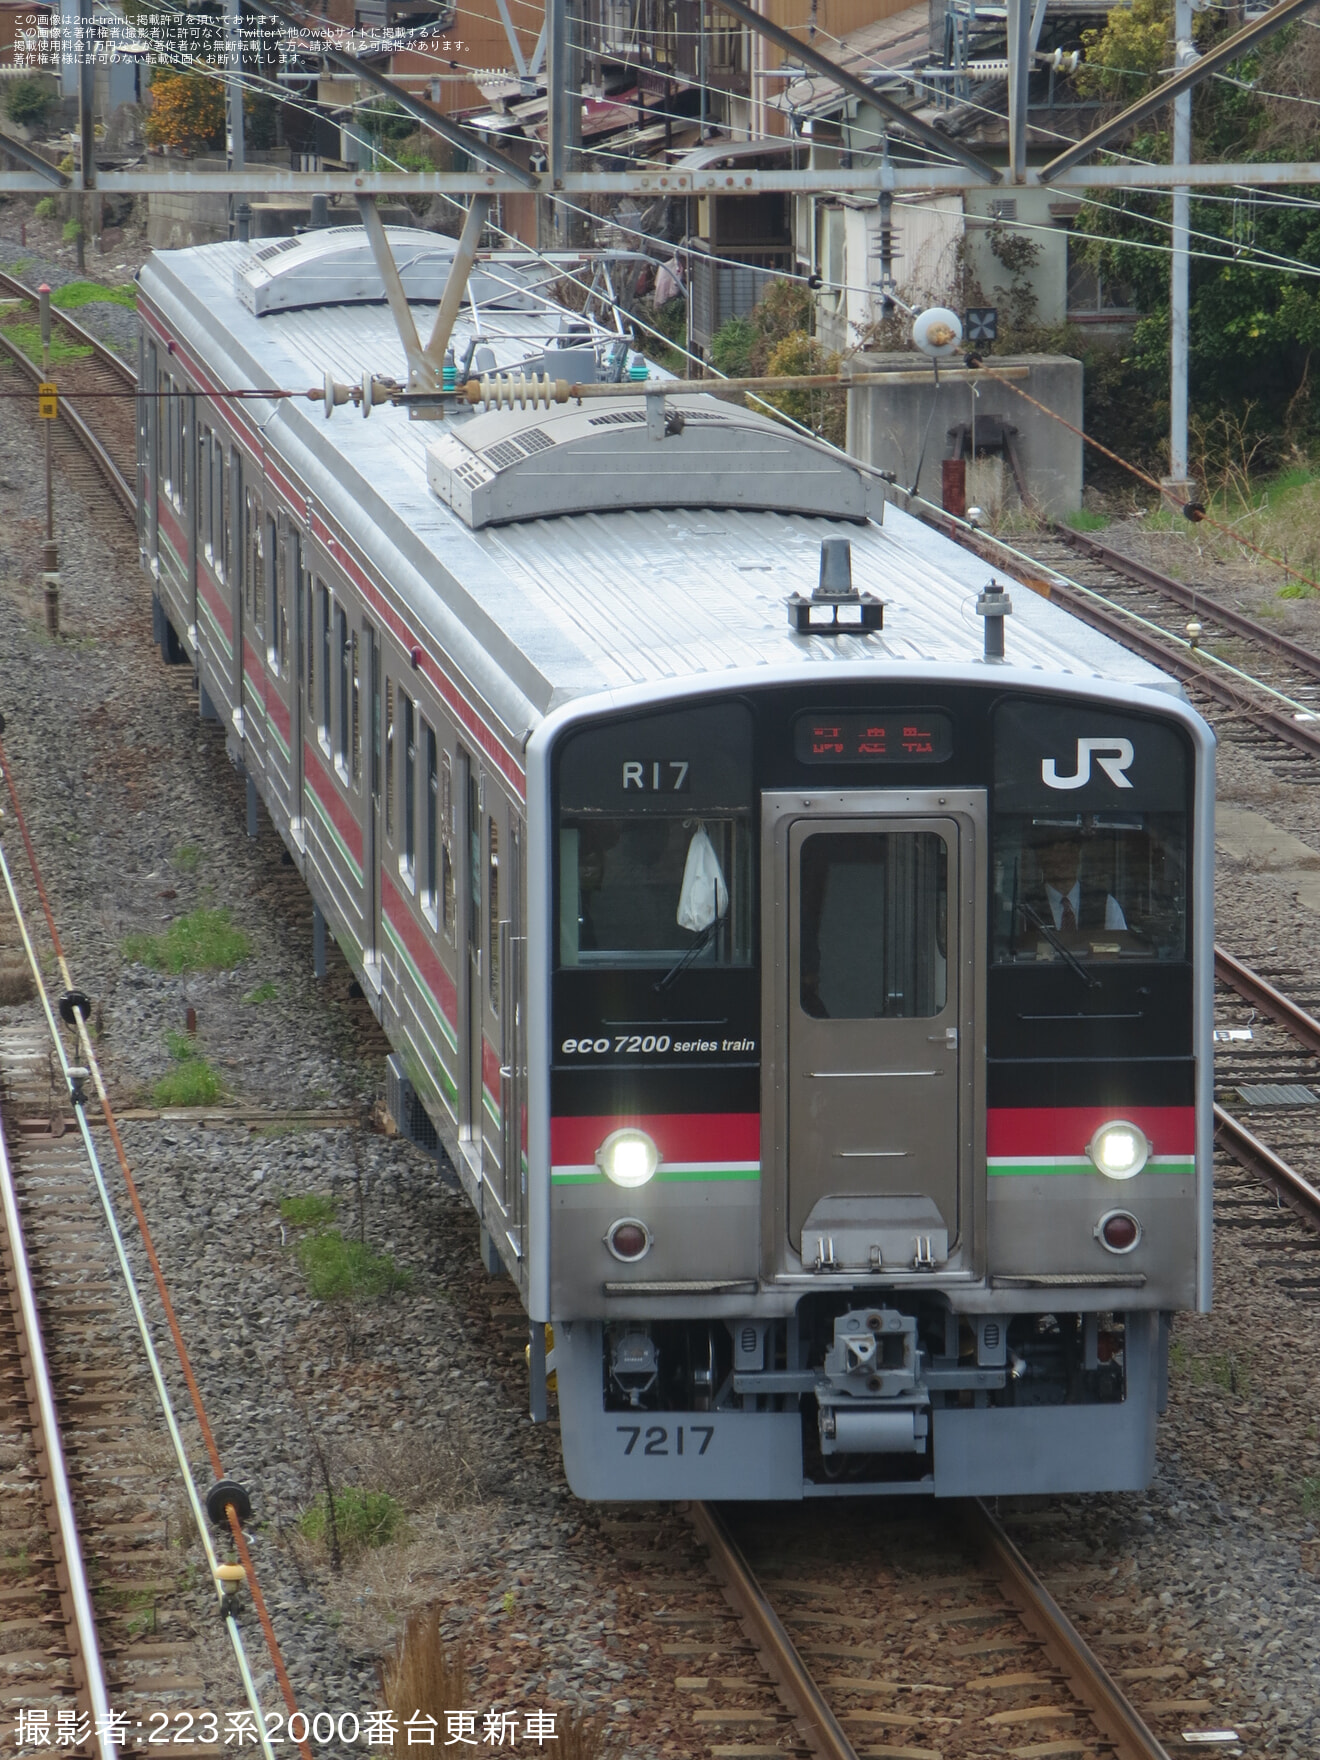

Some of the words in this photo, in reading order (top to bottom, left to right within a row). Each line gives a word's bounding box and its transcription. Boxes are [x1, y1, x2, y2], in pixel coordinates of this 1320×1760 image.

[622, 762, 689, 790] R17
[1042, 738, 1134, 790] JR
[562, 1038, 610, 1054] eco
[614, 1036, 670, 1053] 7200
[673, 1039, 717, 1052] series
[722, 1038, 755, 1052] train
[616, 1426, 715, 1455] 7217
